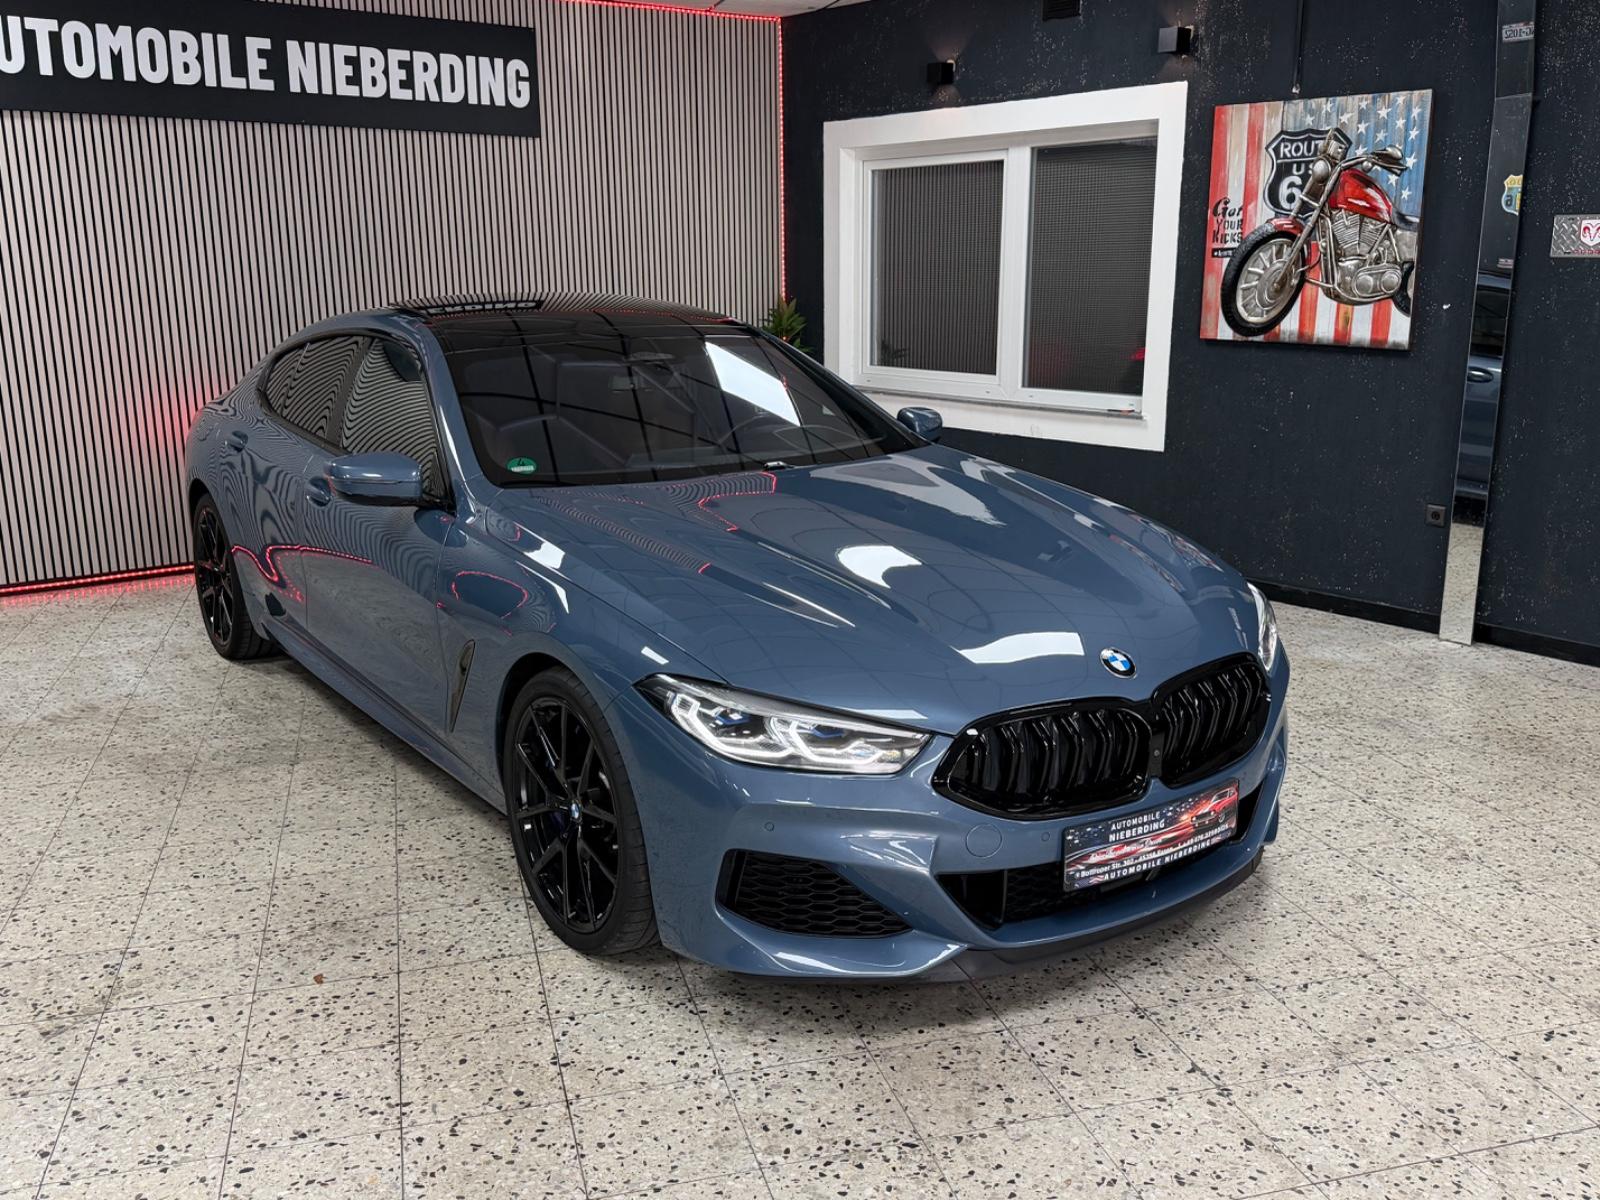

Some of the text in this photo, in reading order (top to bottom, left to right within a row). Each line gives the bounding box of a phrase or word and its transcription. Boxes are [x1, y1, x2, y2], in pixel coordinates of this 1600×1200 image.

[0, 15, 531, 109] UTOMOBILE NIEBERDING
[1280, 139, 1325, 158] ROUT
[1278, 175, 1303, 210] 6
[1108, 819, 1165, 843] NIEBERDING
[1110, 811, 1161, 831] AUTOMOBILE
[1104, 858, 1161, 881] AUTOMOBILE
[1164, 839, 1211, 863] NIEBERDING
